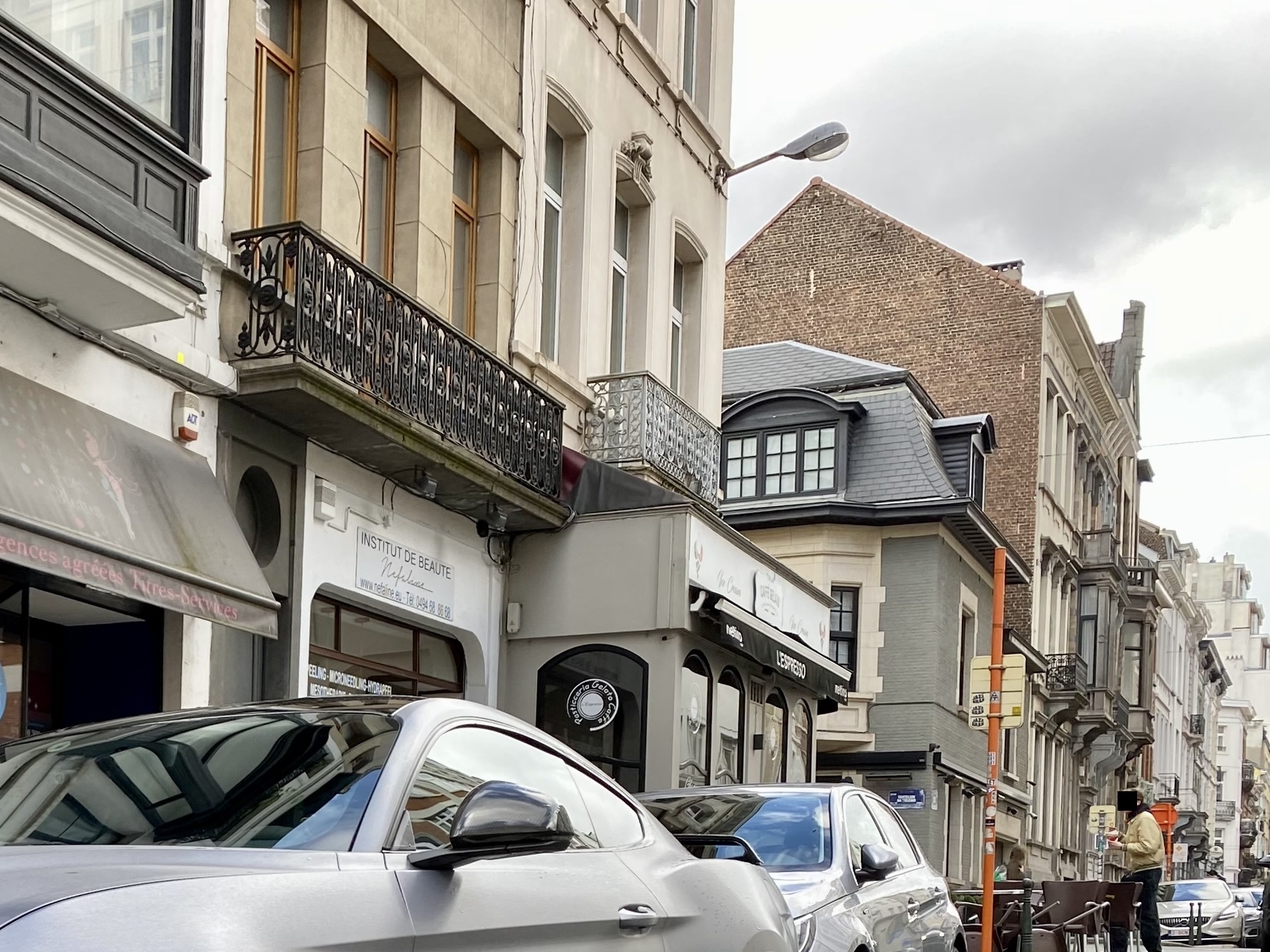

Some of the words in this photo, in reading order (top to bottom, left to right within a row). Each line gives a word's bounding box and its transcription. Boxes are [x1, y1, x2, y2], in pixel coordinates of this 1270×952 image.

[186, 412, 199, 425] ADT
[361, 531, 402, 559] INSTITUT
[404, 549, 416, 566] DE
[419, 555, 451, 580] BEAUTE
[130, 569, 238, 621] Titres-Services
[592, 680, 613, 701] Gelato
